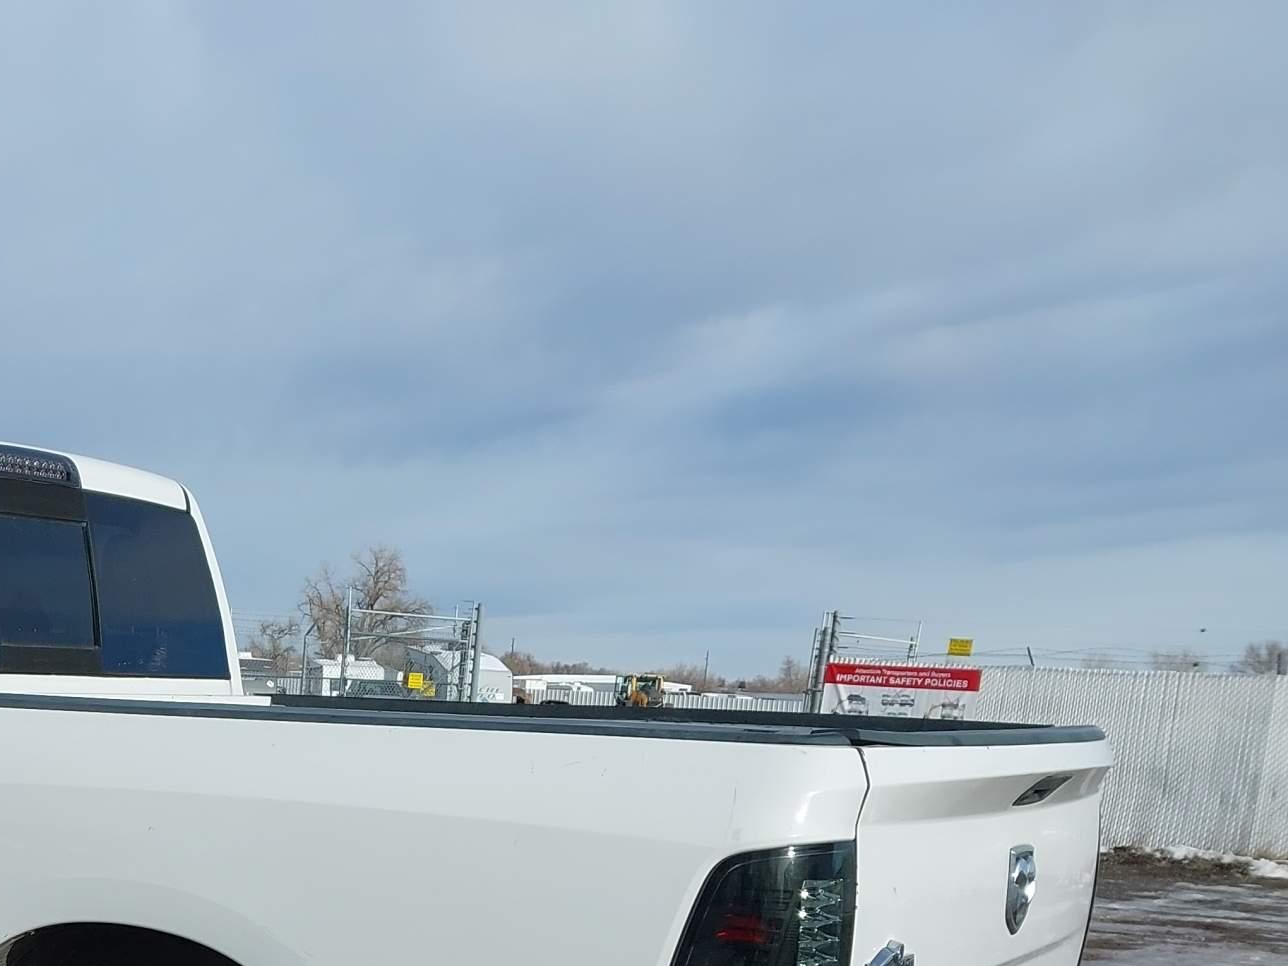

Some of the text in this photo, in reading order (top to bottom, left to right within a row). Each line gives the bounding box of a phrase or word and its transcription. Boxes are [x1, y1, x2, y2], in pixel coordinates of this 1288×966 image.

[836, 674, 969, 688] IMPORTANT SAFETY POLICIES
